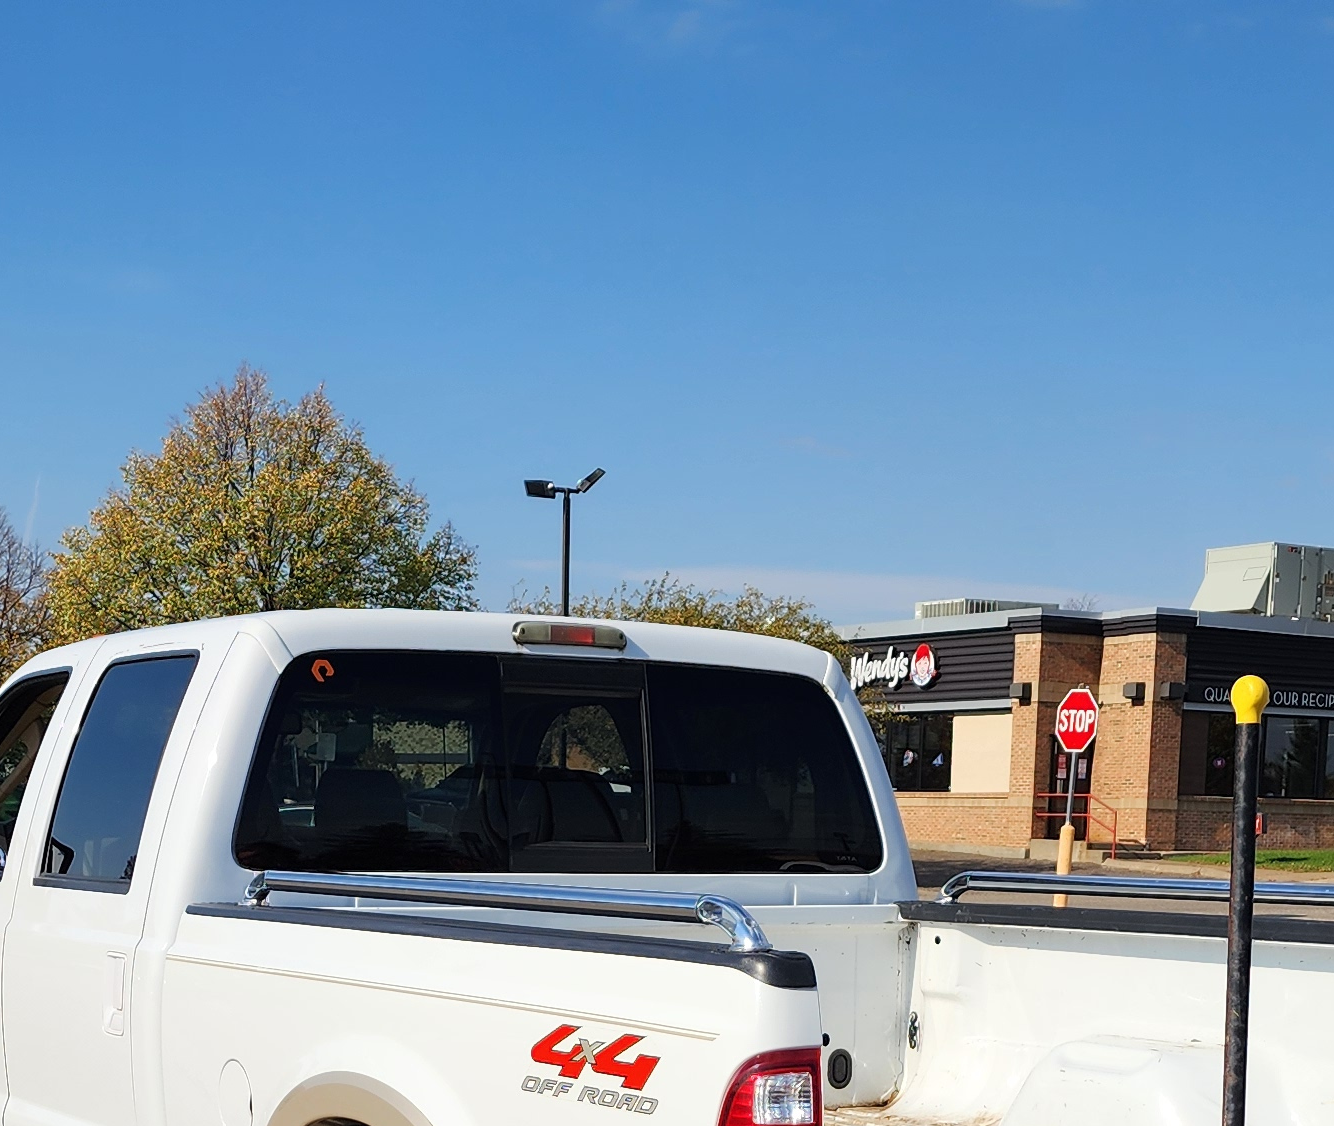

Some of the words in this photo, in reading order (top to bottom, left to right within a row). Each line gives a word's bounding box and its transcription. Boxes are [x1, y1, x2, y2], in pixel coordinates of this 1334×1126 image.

[850, 646, 908, 690] Wendy's
[1274, 691, 1298, 706] OUR
[1059, 709, 1095, 732] STOP
[521, 1075, 574, 1097] OFF
[577, 1085, 659, 1115] ROAD
